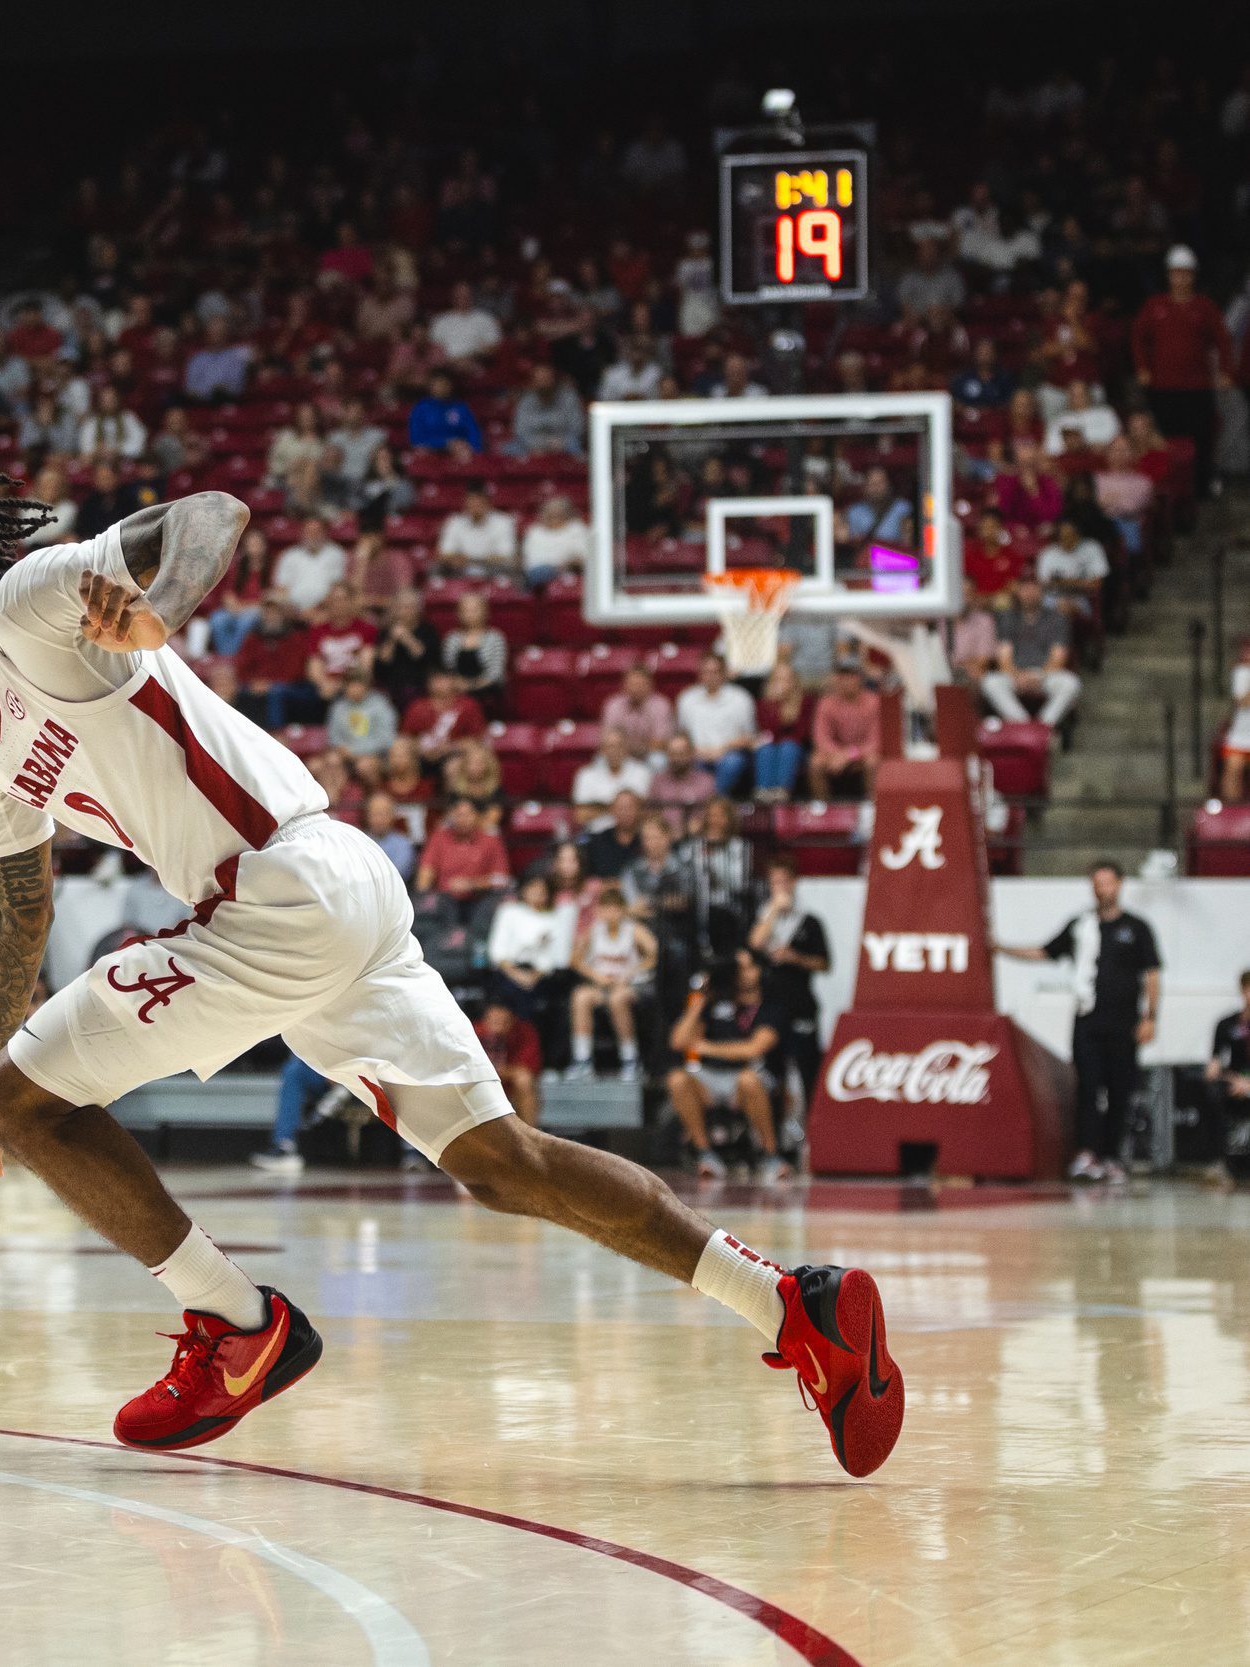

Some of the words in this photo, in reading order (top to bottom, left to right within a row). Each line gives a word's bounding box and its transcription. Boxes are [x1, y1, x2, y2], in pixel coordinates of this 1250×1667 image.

[775, 168, 852, 210] 1:41
[776, 209, 843, 283] 19
[879, 804, 946, 870] A
[863, 933, 969, 973] YETI
[107, 956, 196, 1024] A
